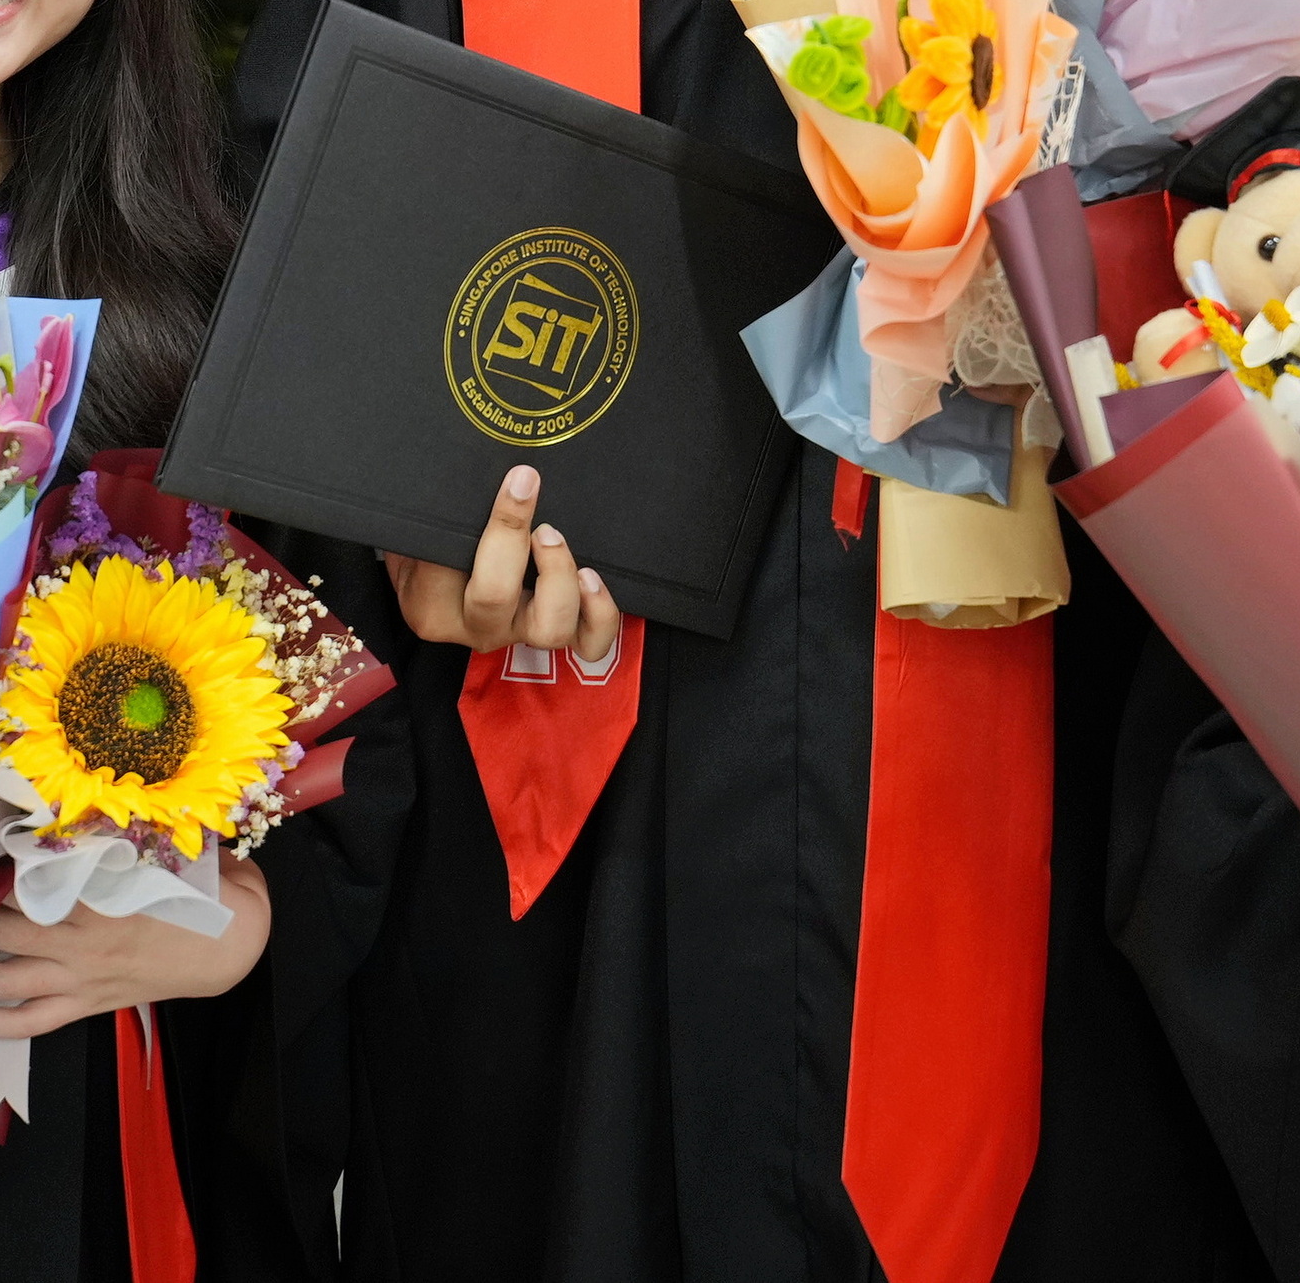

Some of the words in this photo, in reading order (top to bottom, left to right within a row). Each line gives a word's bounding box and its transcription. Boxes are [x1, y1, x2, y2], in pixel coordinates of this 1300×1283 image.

[461, 248, 519, 327] SINGAPORE
[521, 239, 590, 260] INSTITUTE
[589, 254, 608, 273] OF
[603, 270, 629, 375] TECHNOLOGY
[461, 376, 533, 435] Established
[537, 410, 575, 435] 2009
